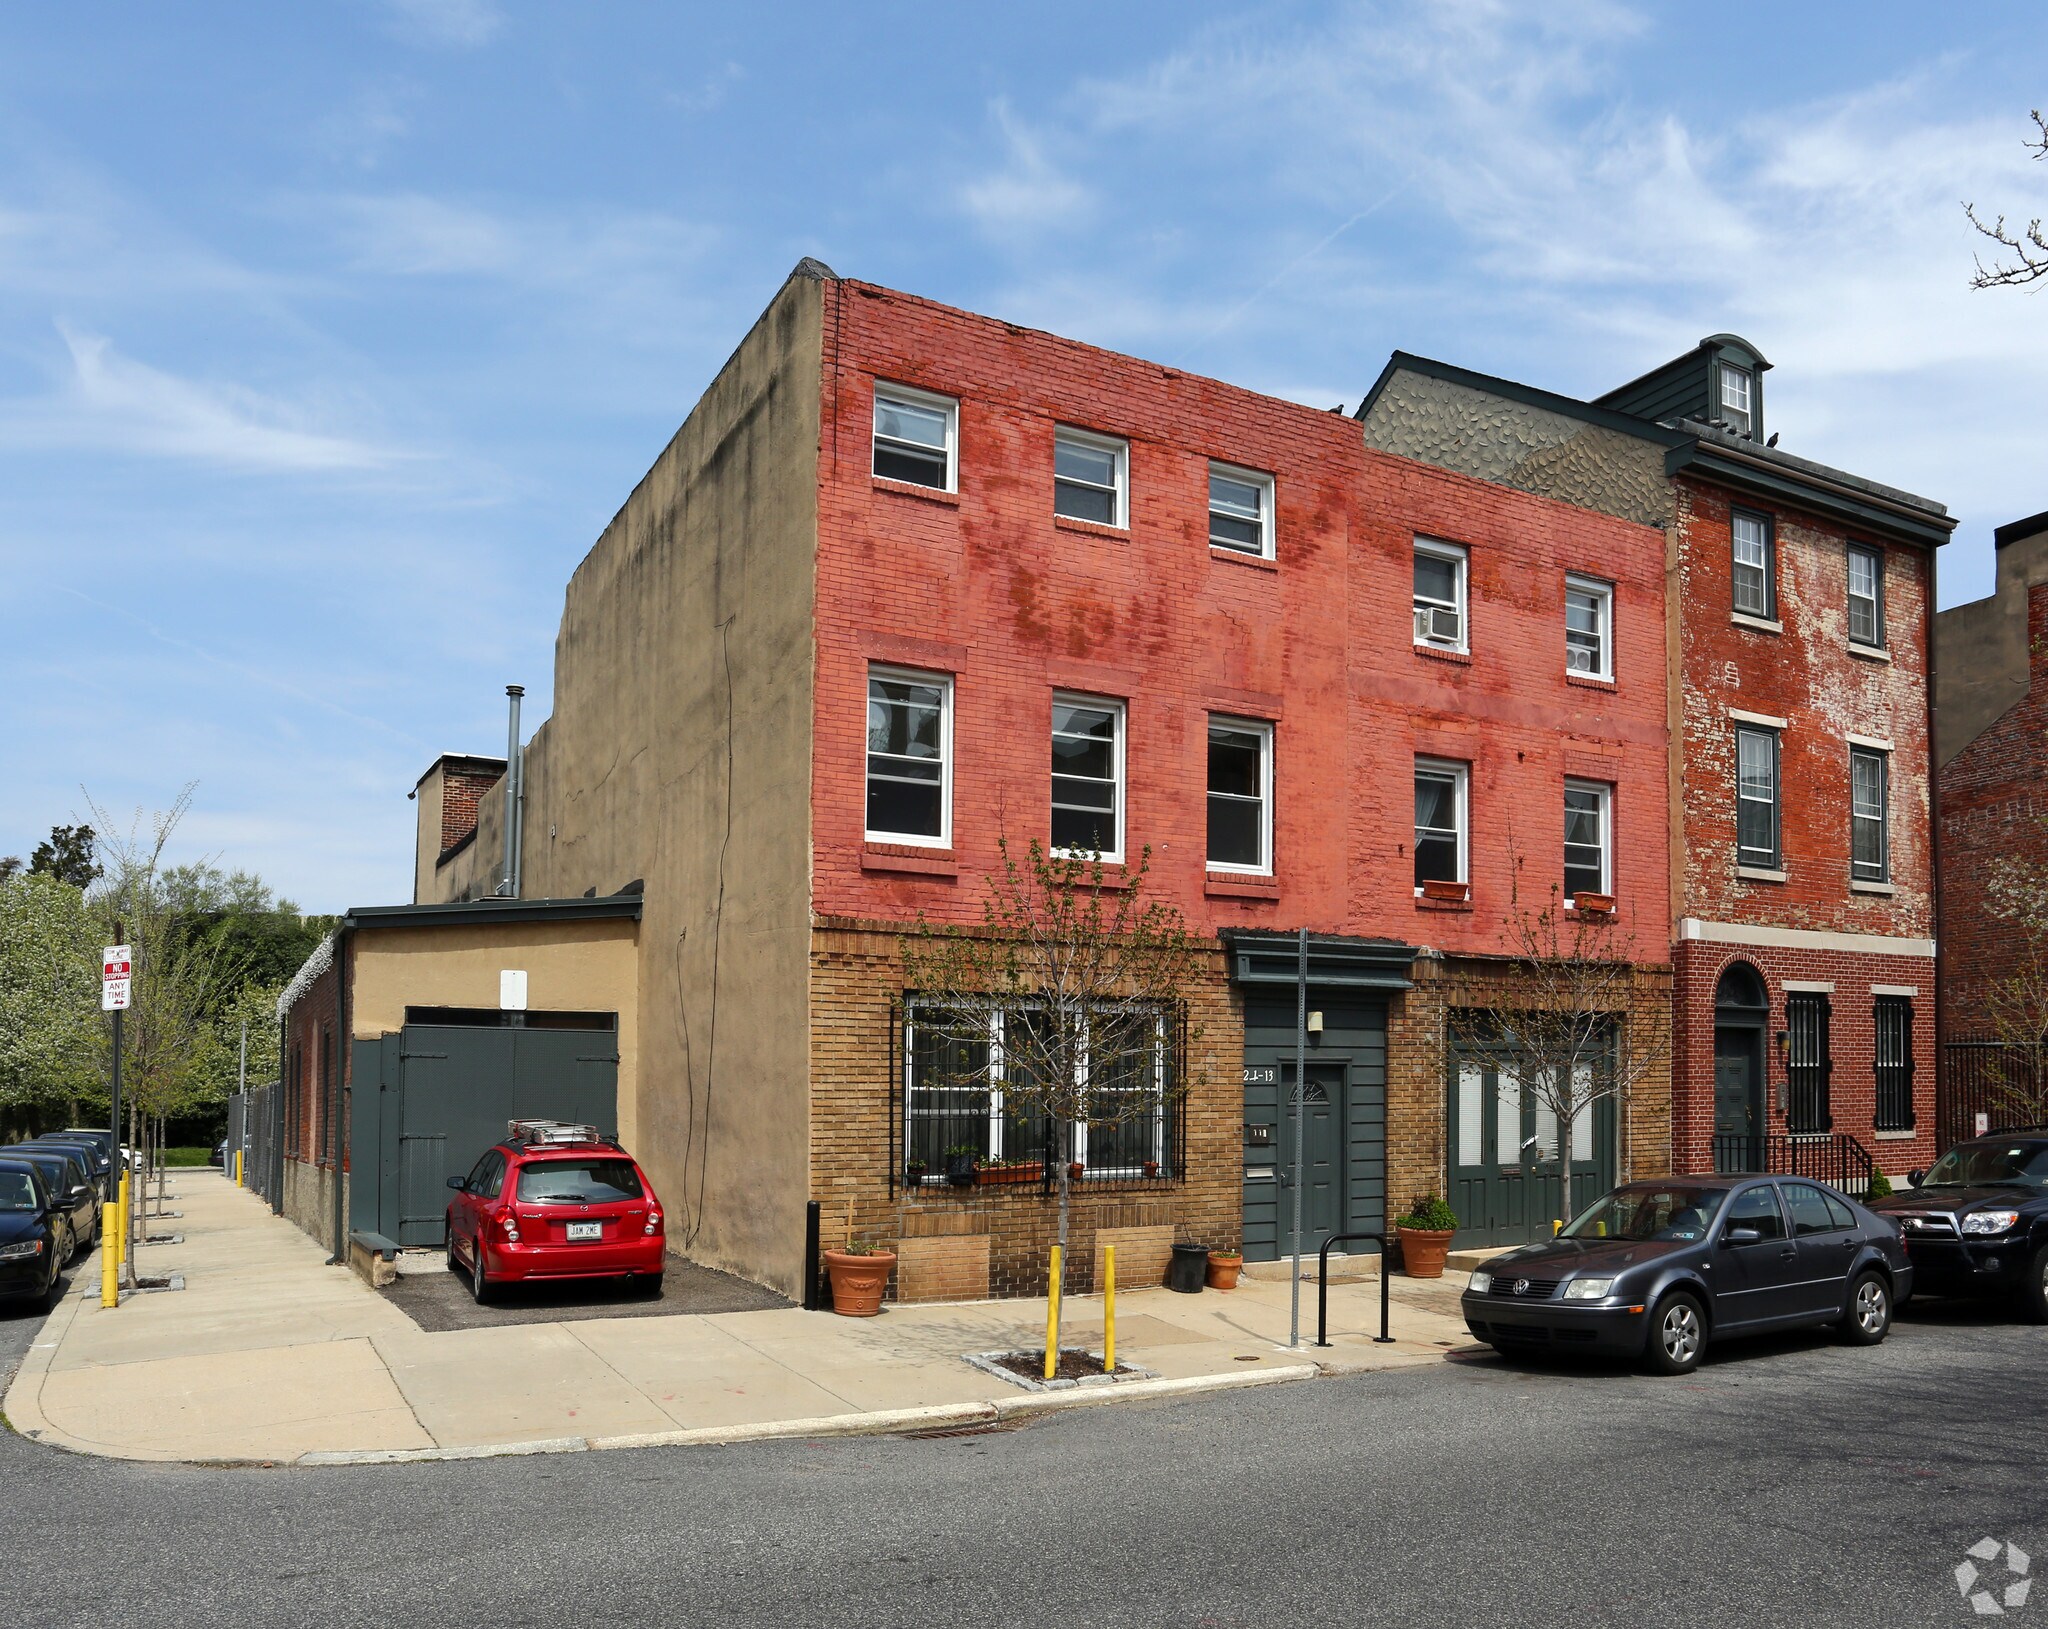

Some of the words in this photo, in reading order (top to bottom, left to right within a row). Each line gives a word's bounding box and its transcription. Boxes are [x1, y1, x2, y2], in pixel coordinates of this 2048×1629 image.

[112, 964, 122, 972] NO
[106, 972, 129, 980] STOPPING
[109, 982, 126, 990] ANY
[108, 991, 126, 999] TIME
[571, 1226, 584, 1236] JAM
